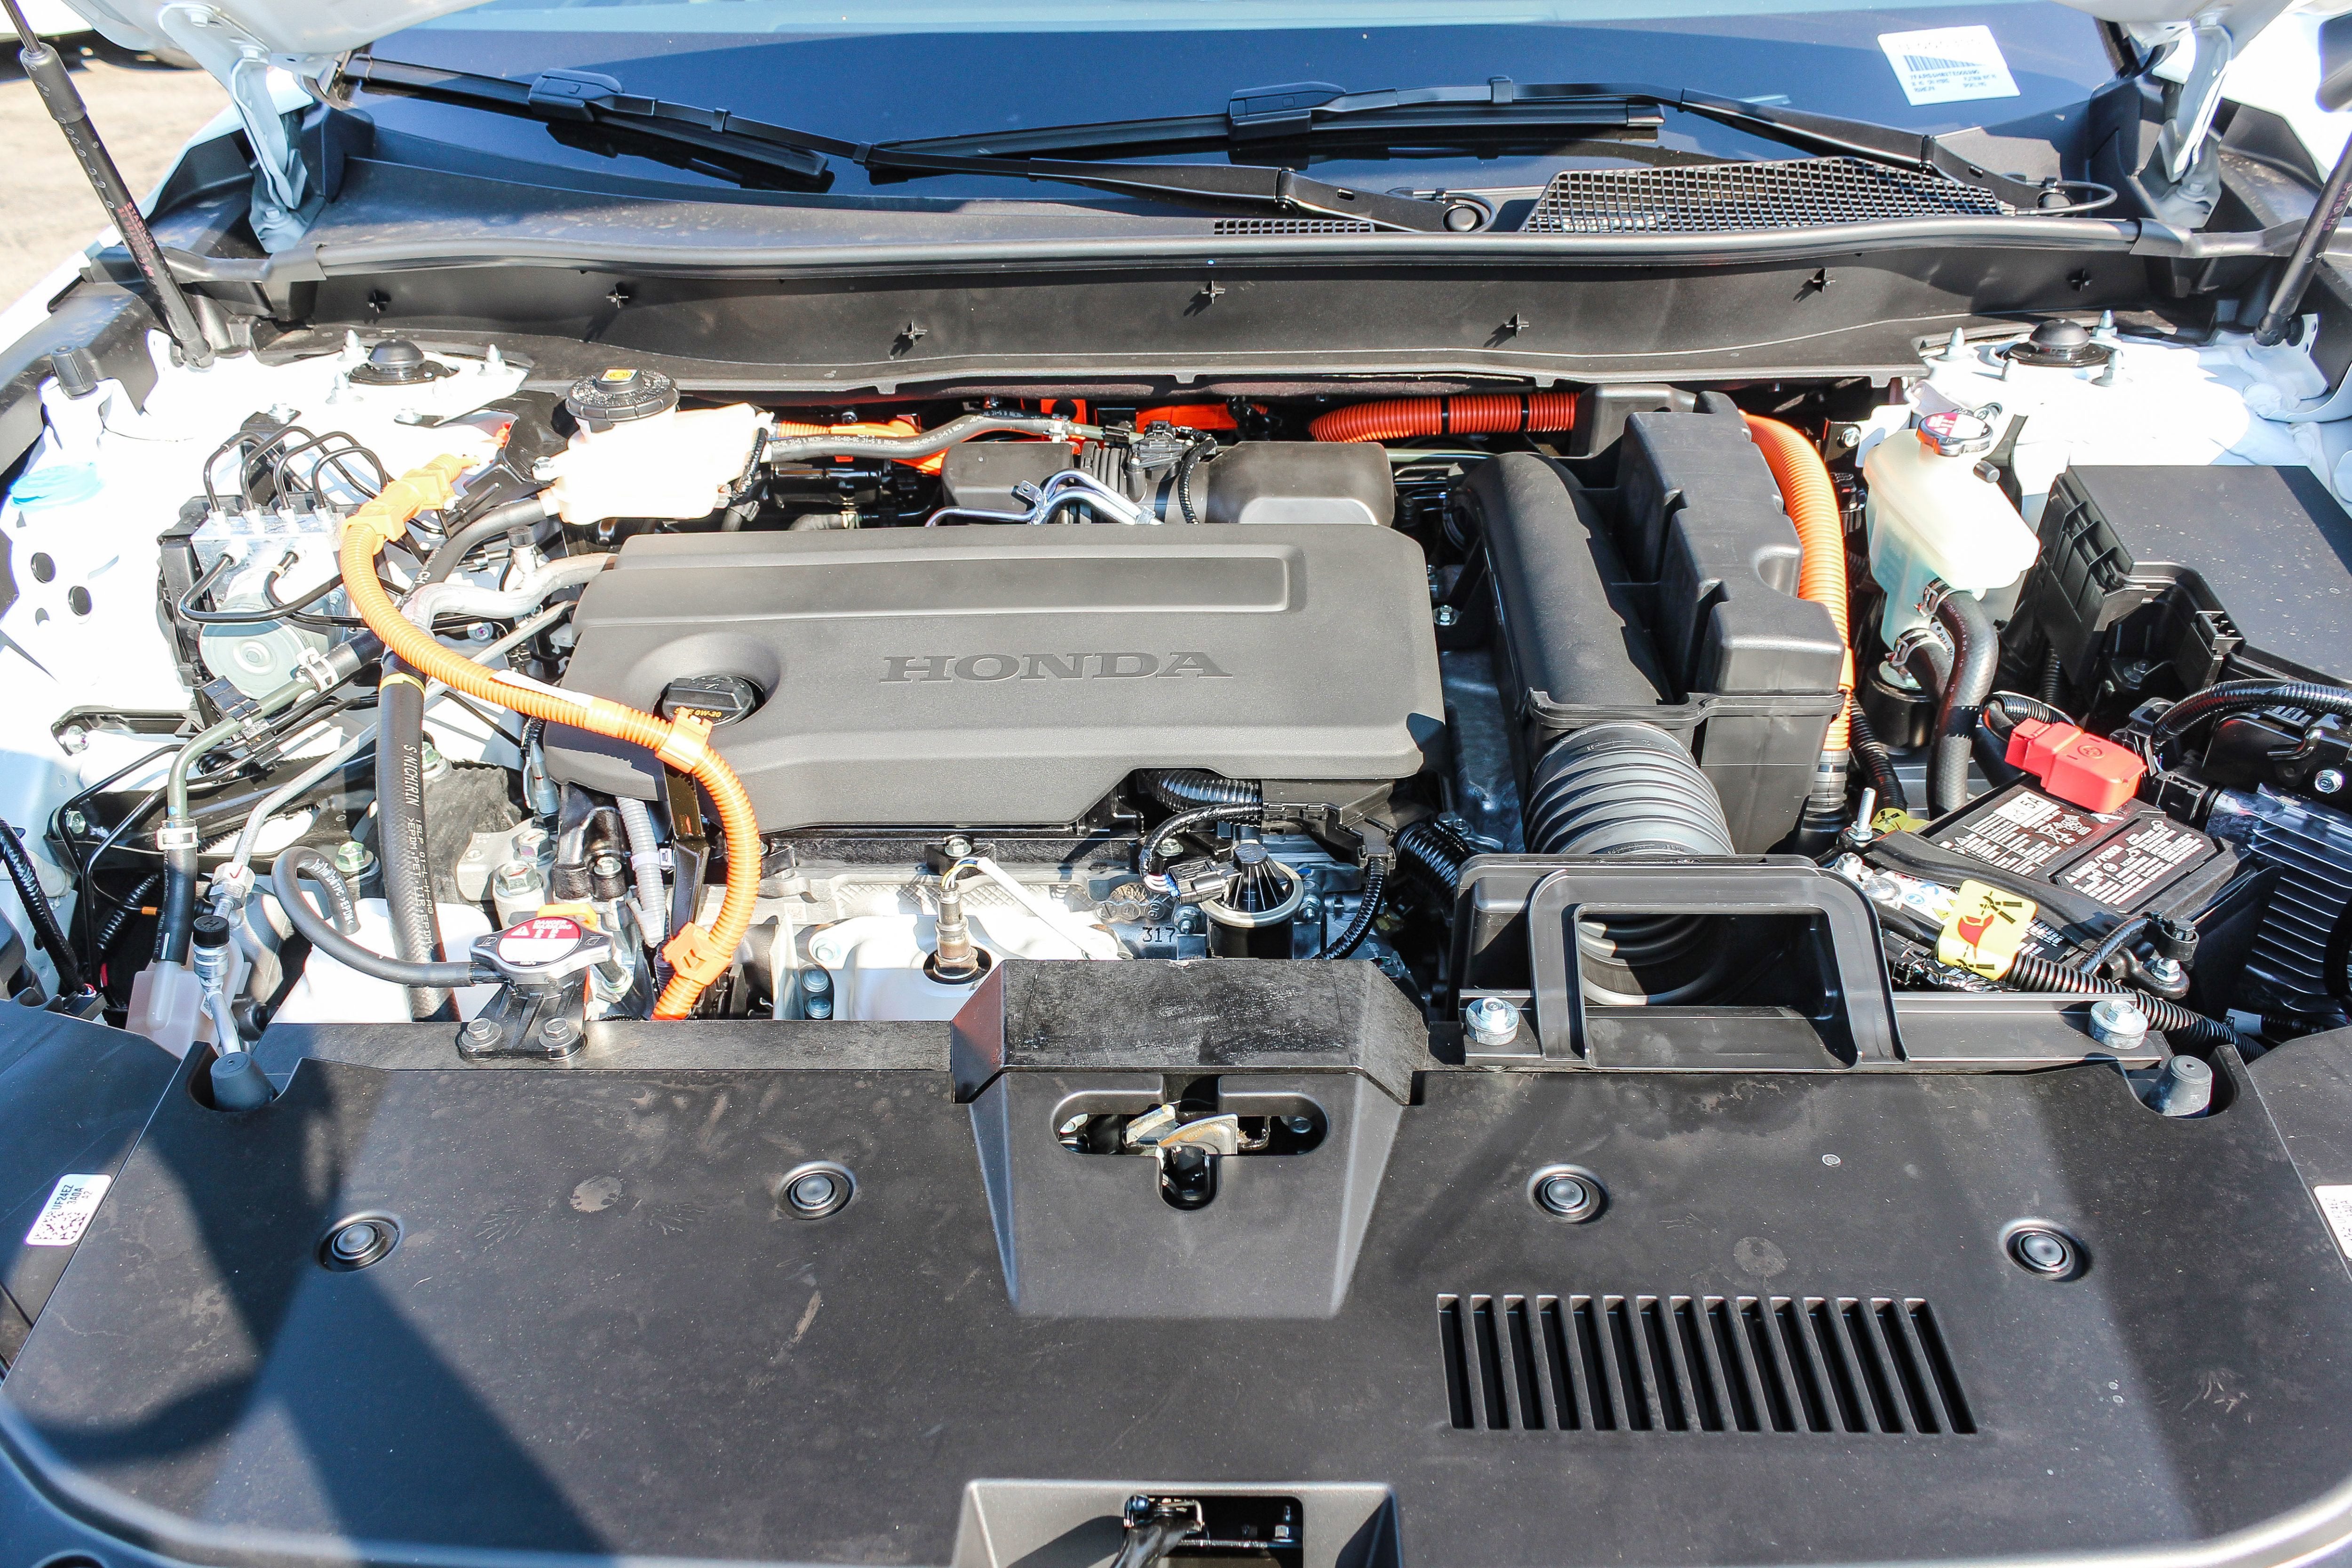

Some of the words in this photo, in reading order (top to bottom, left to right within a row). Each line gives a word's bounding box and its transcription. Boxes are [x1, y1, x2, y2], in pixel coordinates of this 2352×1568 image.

[125, 201, 156, 250] STABILUS
[880, 652, 1233, 683] HONDA
[2020, 796, 2043, 809] 5A
[331, 882, 345, 897] TPC
[1142, 927, 1176, 942] 317
[51, 1185, 74, 1210] UF24EZ
